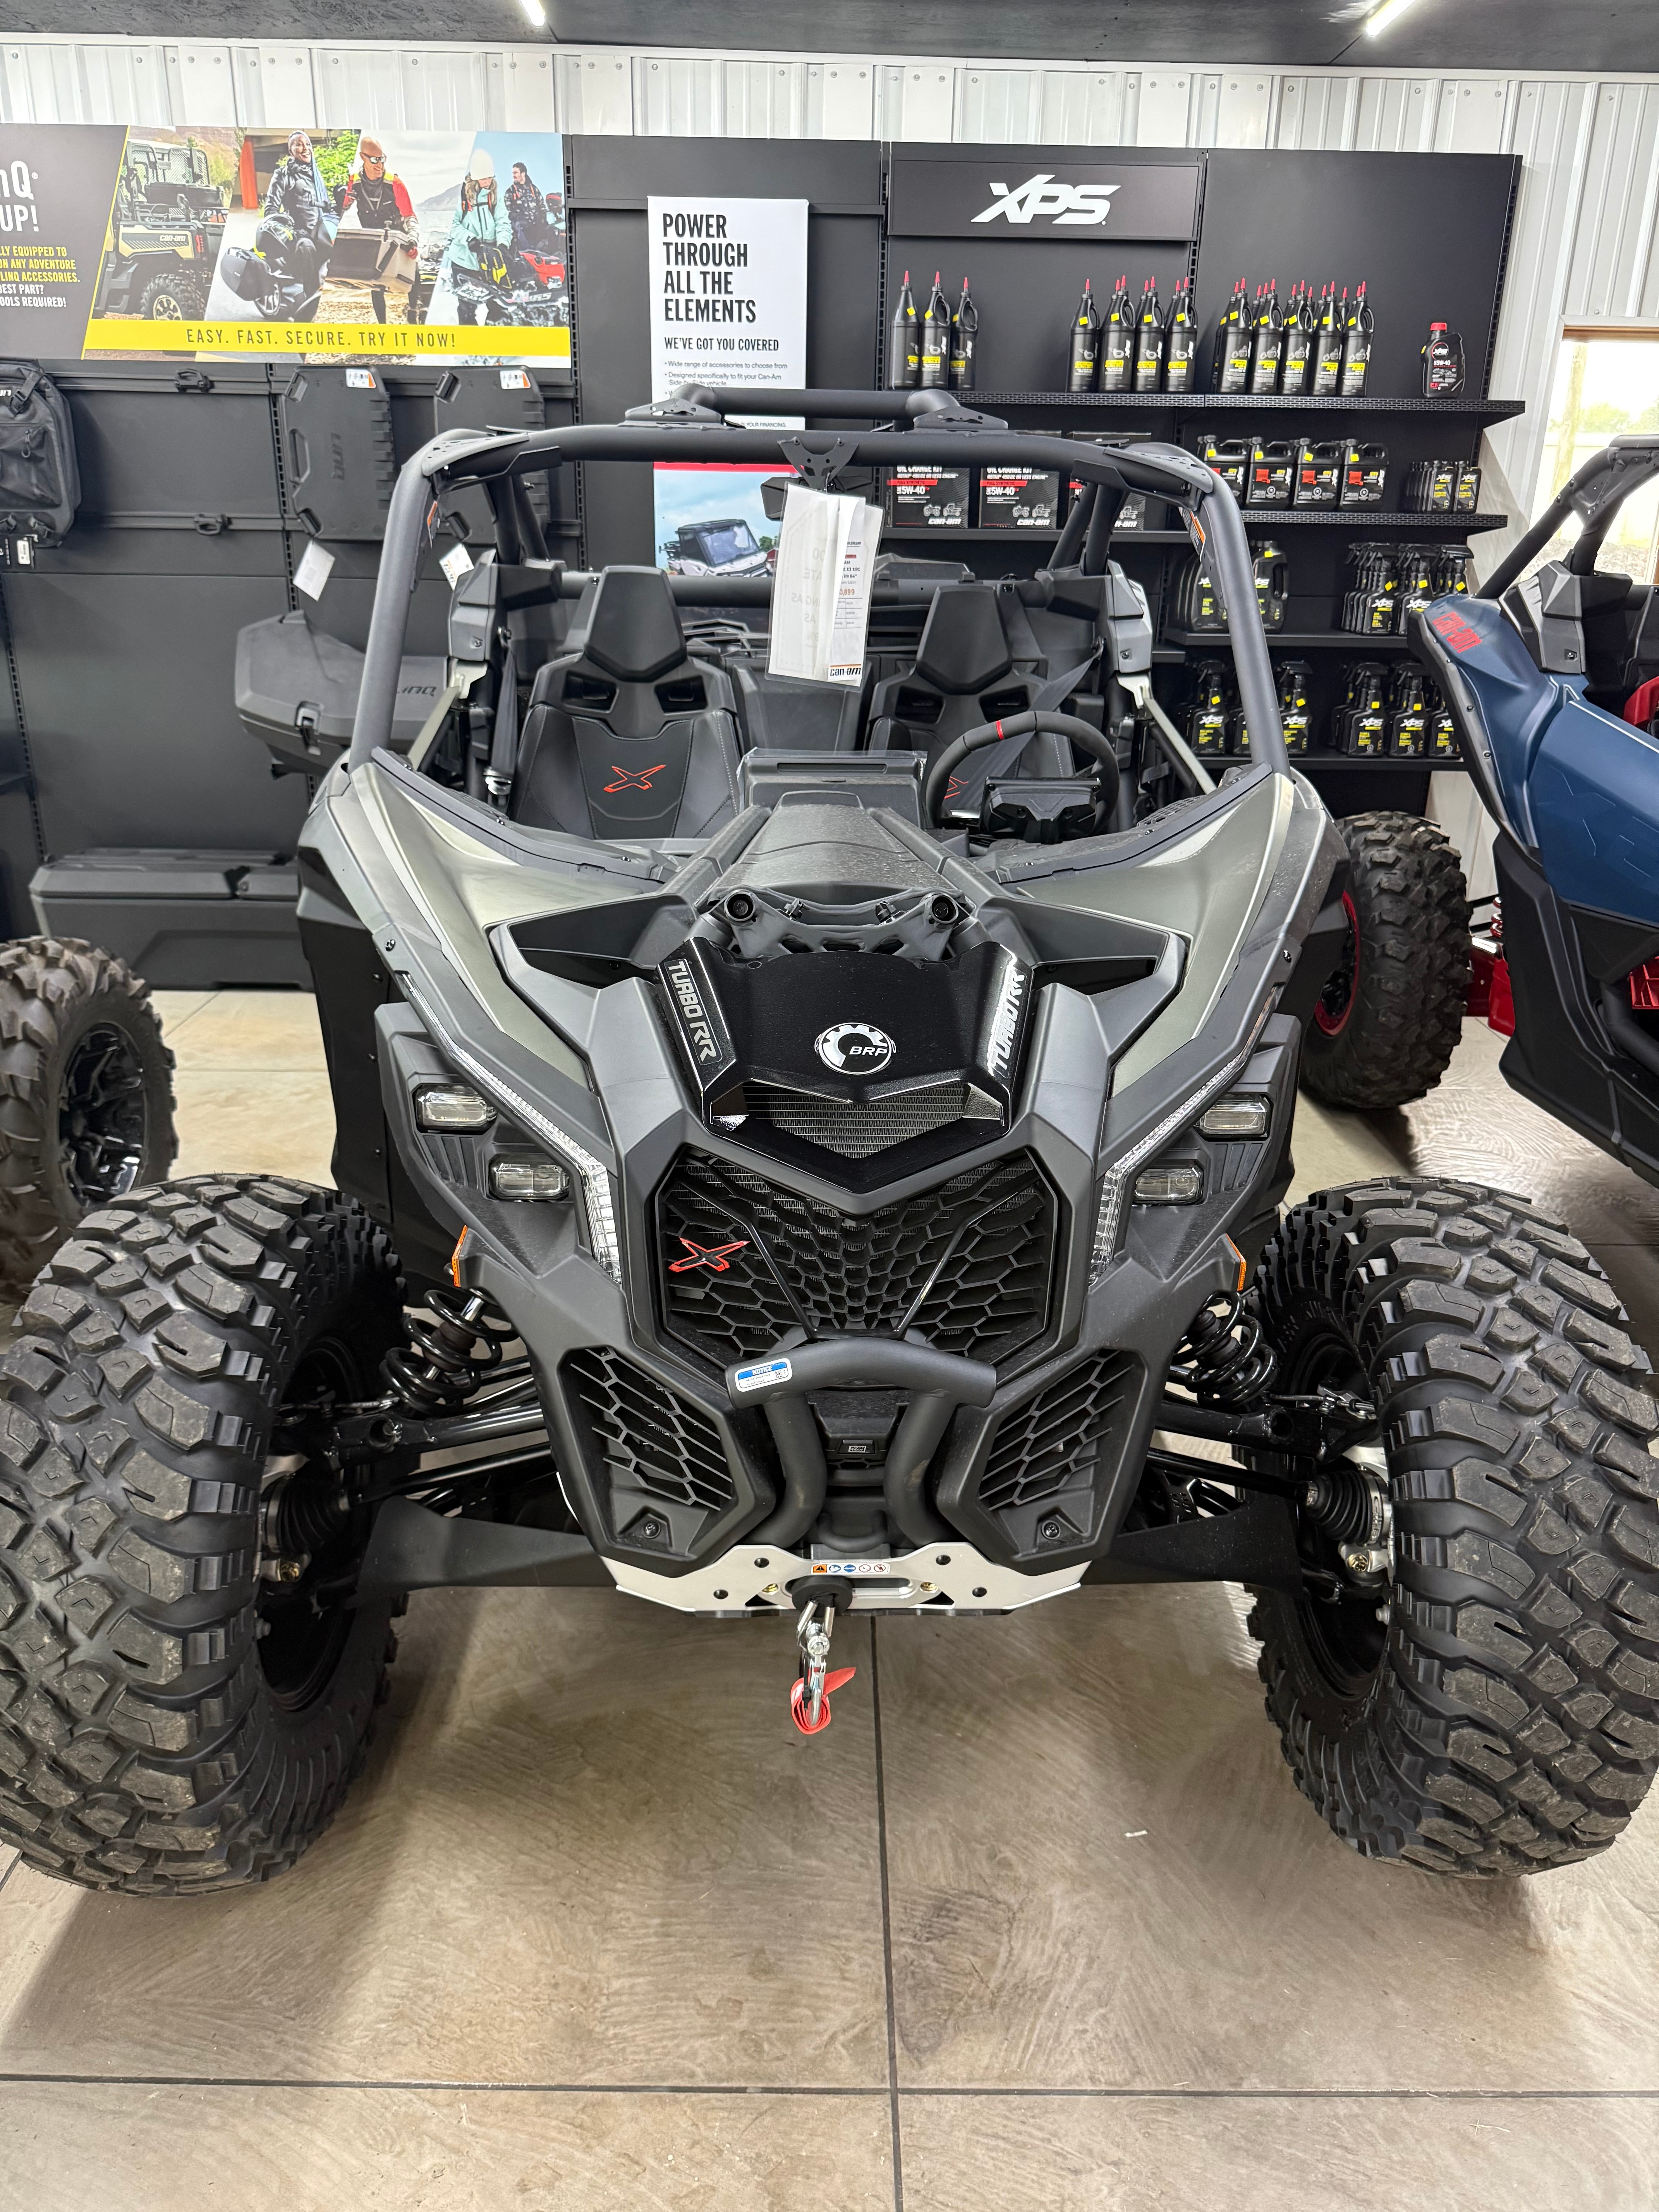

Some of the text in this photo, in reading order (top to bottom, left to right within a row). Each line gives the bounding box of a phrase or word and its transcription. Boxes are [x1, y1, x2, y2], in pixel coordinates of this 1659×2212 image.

[970, 174, 1121, 225] XPS
[0, 205, 39, 232] UP!
[663, 213, 727, 238] POWER
[12, 246, 54, 257] EQUIPPED
[56, 247, 67, 257] TO
[663, 242, 748, 267] THROUGH
[11, 259, 26, 269] ANY
[29, 259, 76, 270] ADVENTURE
[0, 271, 80, 282] LINQ ACCESSORIES.
[664, 271, 733, 295] ALL THE
[19, 284, 44, 294] PART?
[22, 297, 67, 307] REQUIRED!
[665, 299, 756, 323] ELEMENTS
[187, 329, 456, 347] EASY. FAST. SECURE. TRY IT NOW!
[664, 337, 779, 351] WE'VE GOT YOU COVERED
[1371, 598, 1394, 608] XPS
[1406, 599, 1432, 608] XPS
[1432, 611, 1482, 653] can-am
[830, 668, 861, 676] can-am
[1199, 715, 1224, 724] XPS
[1283, 715, 1308, 725] XPS
[1359, 717, 1384, 726] XPS
[1400, 718, 1424, 727] XPS
[668, 961, 716, 1062] TURBO RR
[989, 970, 1025, 1070] TURBO RR
[849, 1046, 888, 1056] BRP
[752, 1365, 773, 1375] NOTICE
